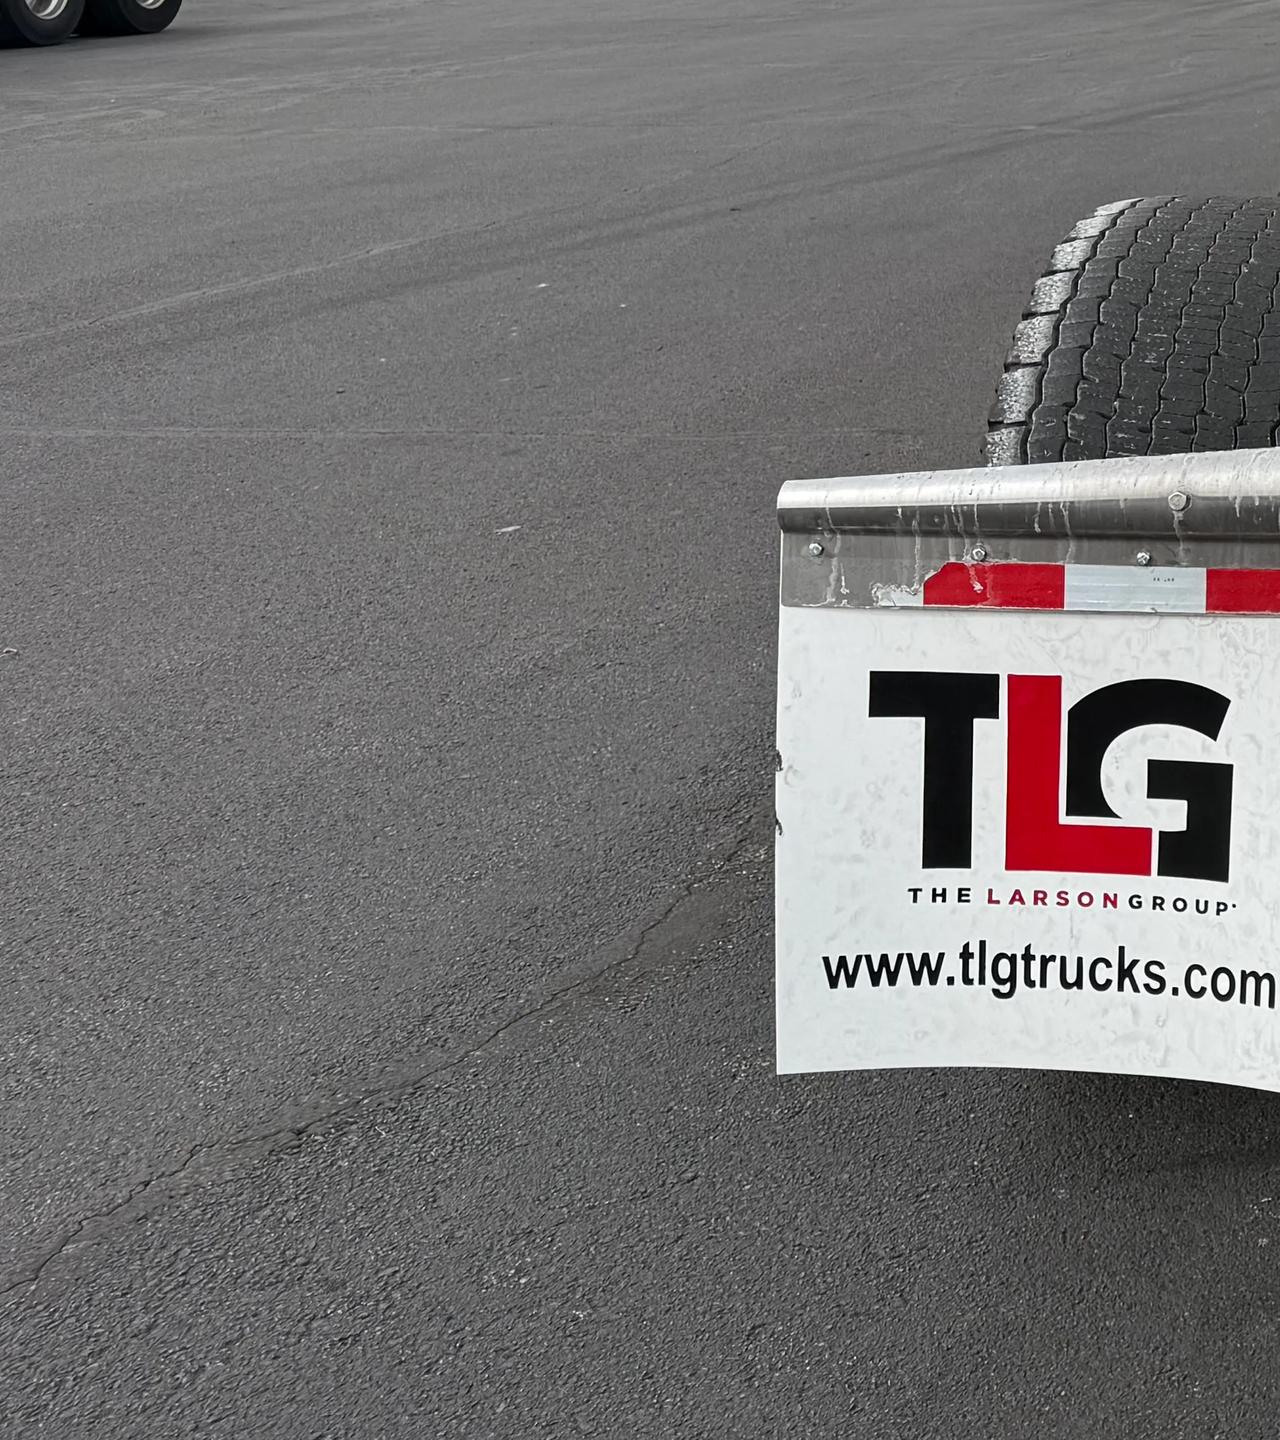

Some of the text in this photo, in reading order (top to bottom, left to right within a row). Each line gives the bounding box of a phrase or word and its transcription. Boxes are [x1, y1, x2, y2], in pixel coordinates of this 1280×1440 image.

[868, 670, 1234, 883] TLG
[908, 886, 971, 905] THE
[822, 940, 1277, 1010] www.tlgtrucks.com
